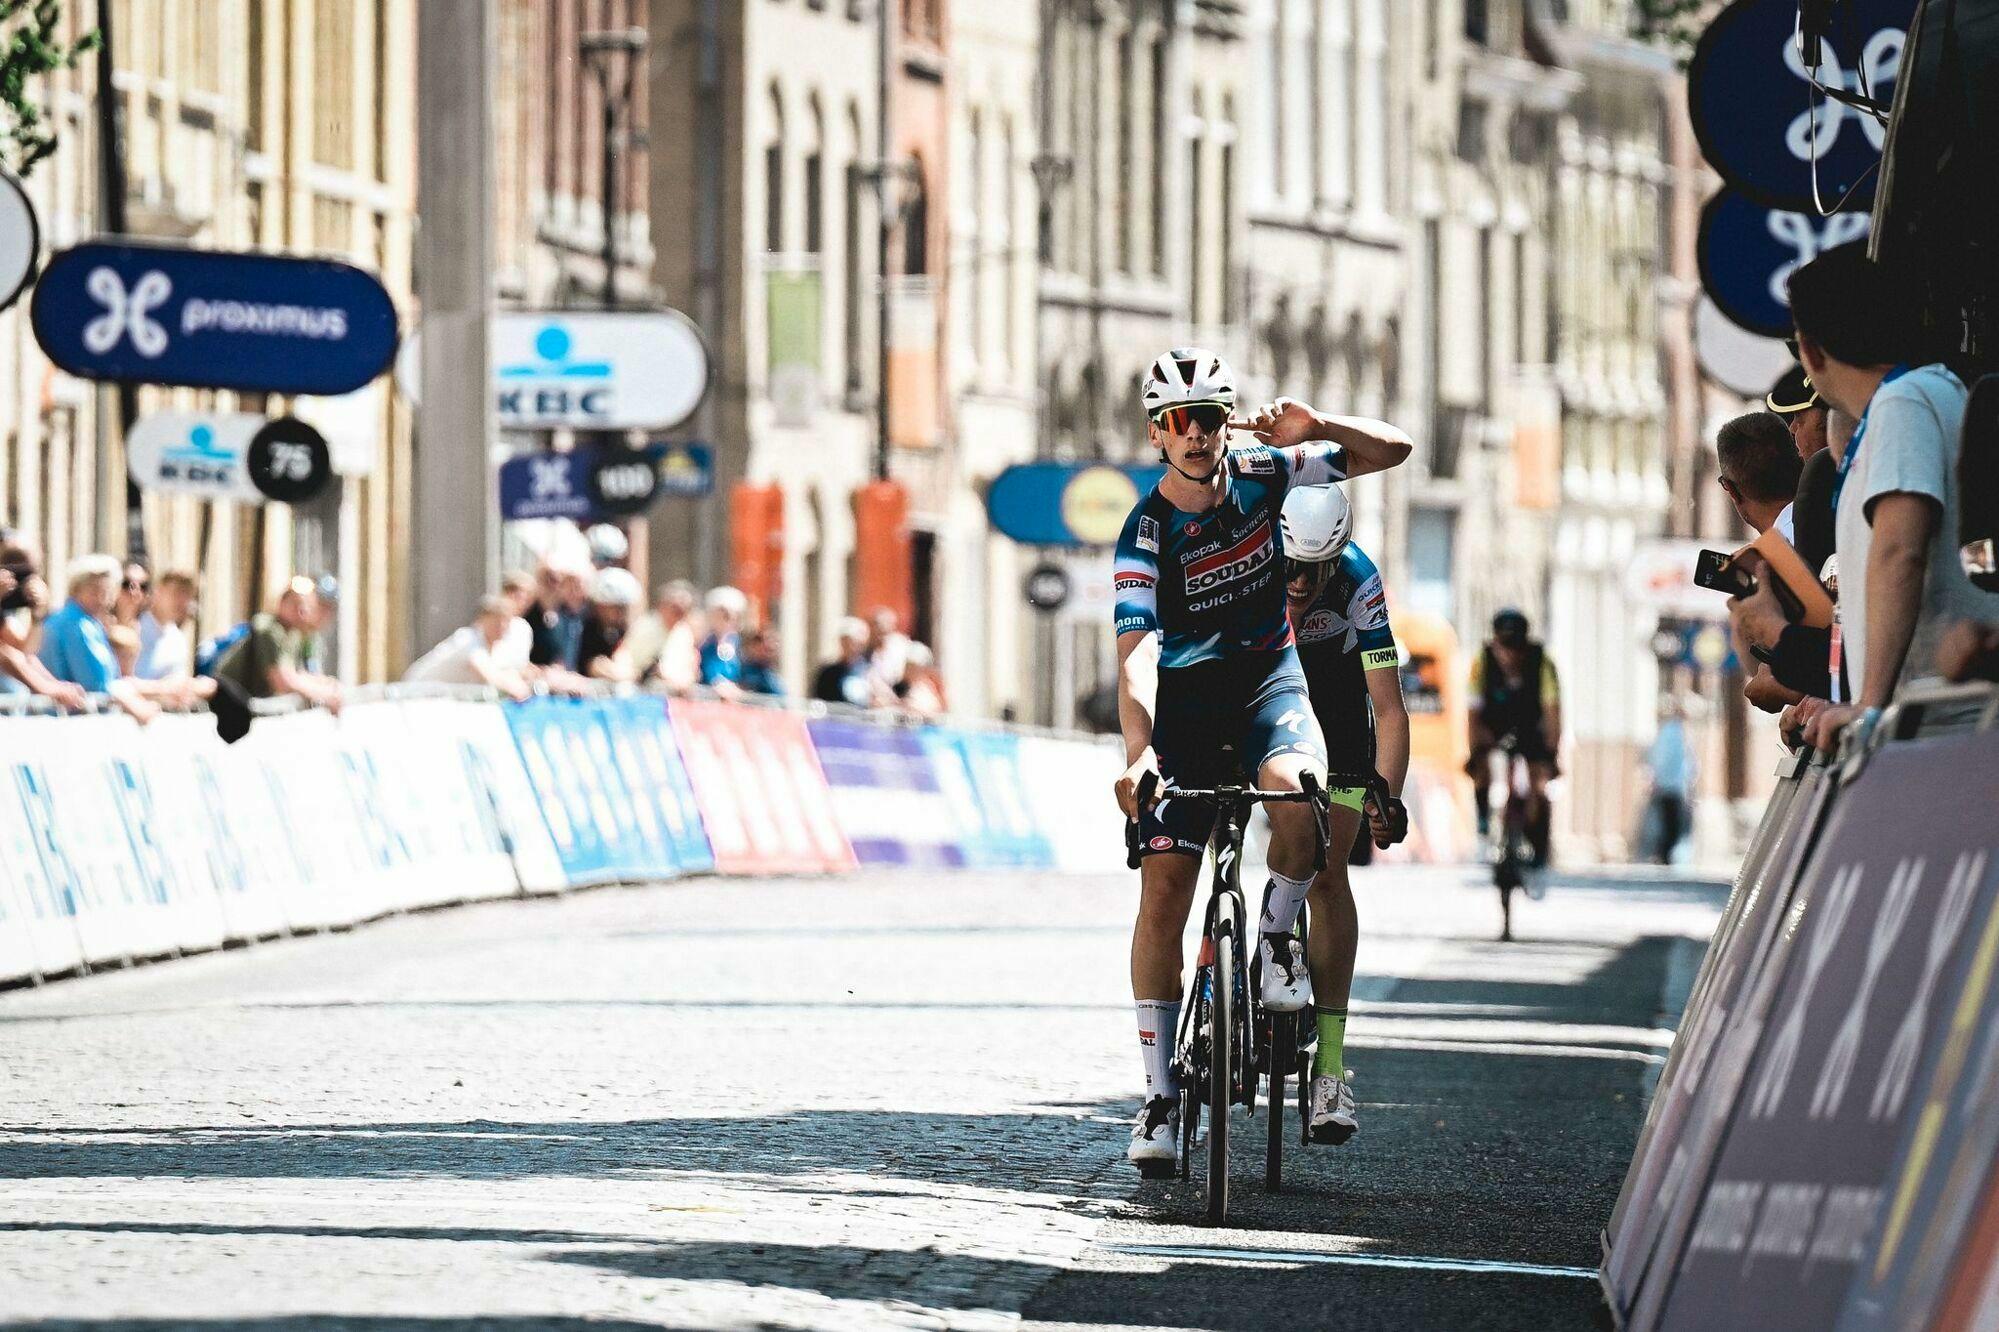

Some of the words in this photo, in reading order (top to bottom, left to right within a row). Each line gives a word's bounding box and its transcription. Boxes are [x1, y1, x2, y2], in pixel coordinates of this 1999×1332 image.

[499, 388, 611, 415] KBC
[270, 441, 312, 481] 75
[1180, 541, 1222, 564] Ekopak
[1187, 541, 1272, 593] SOUDAL
[1115, 579, 1153, 592] OUDAL
[1116, 616, 1145, 629] nom
